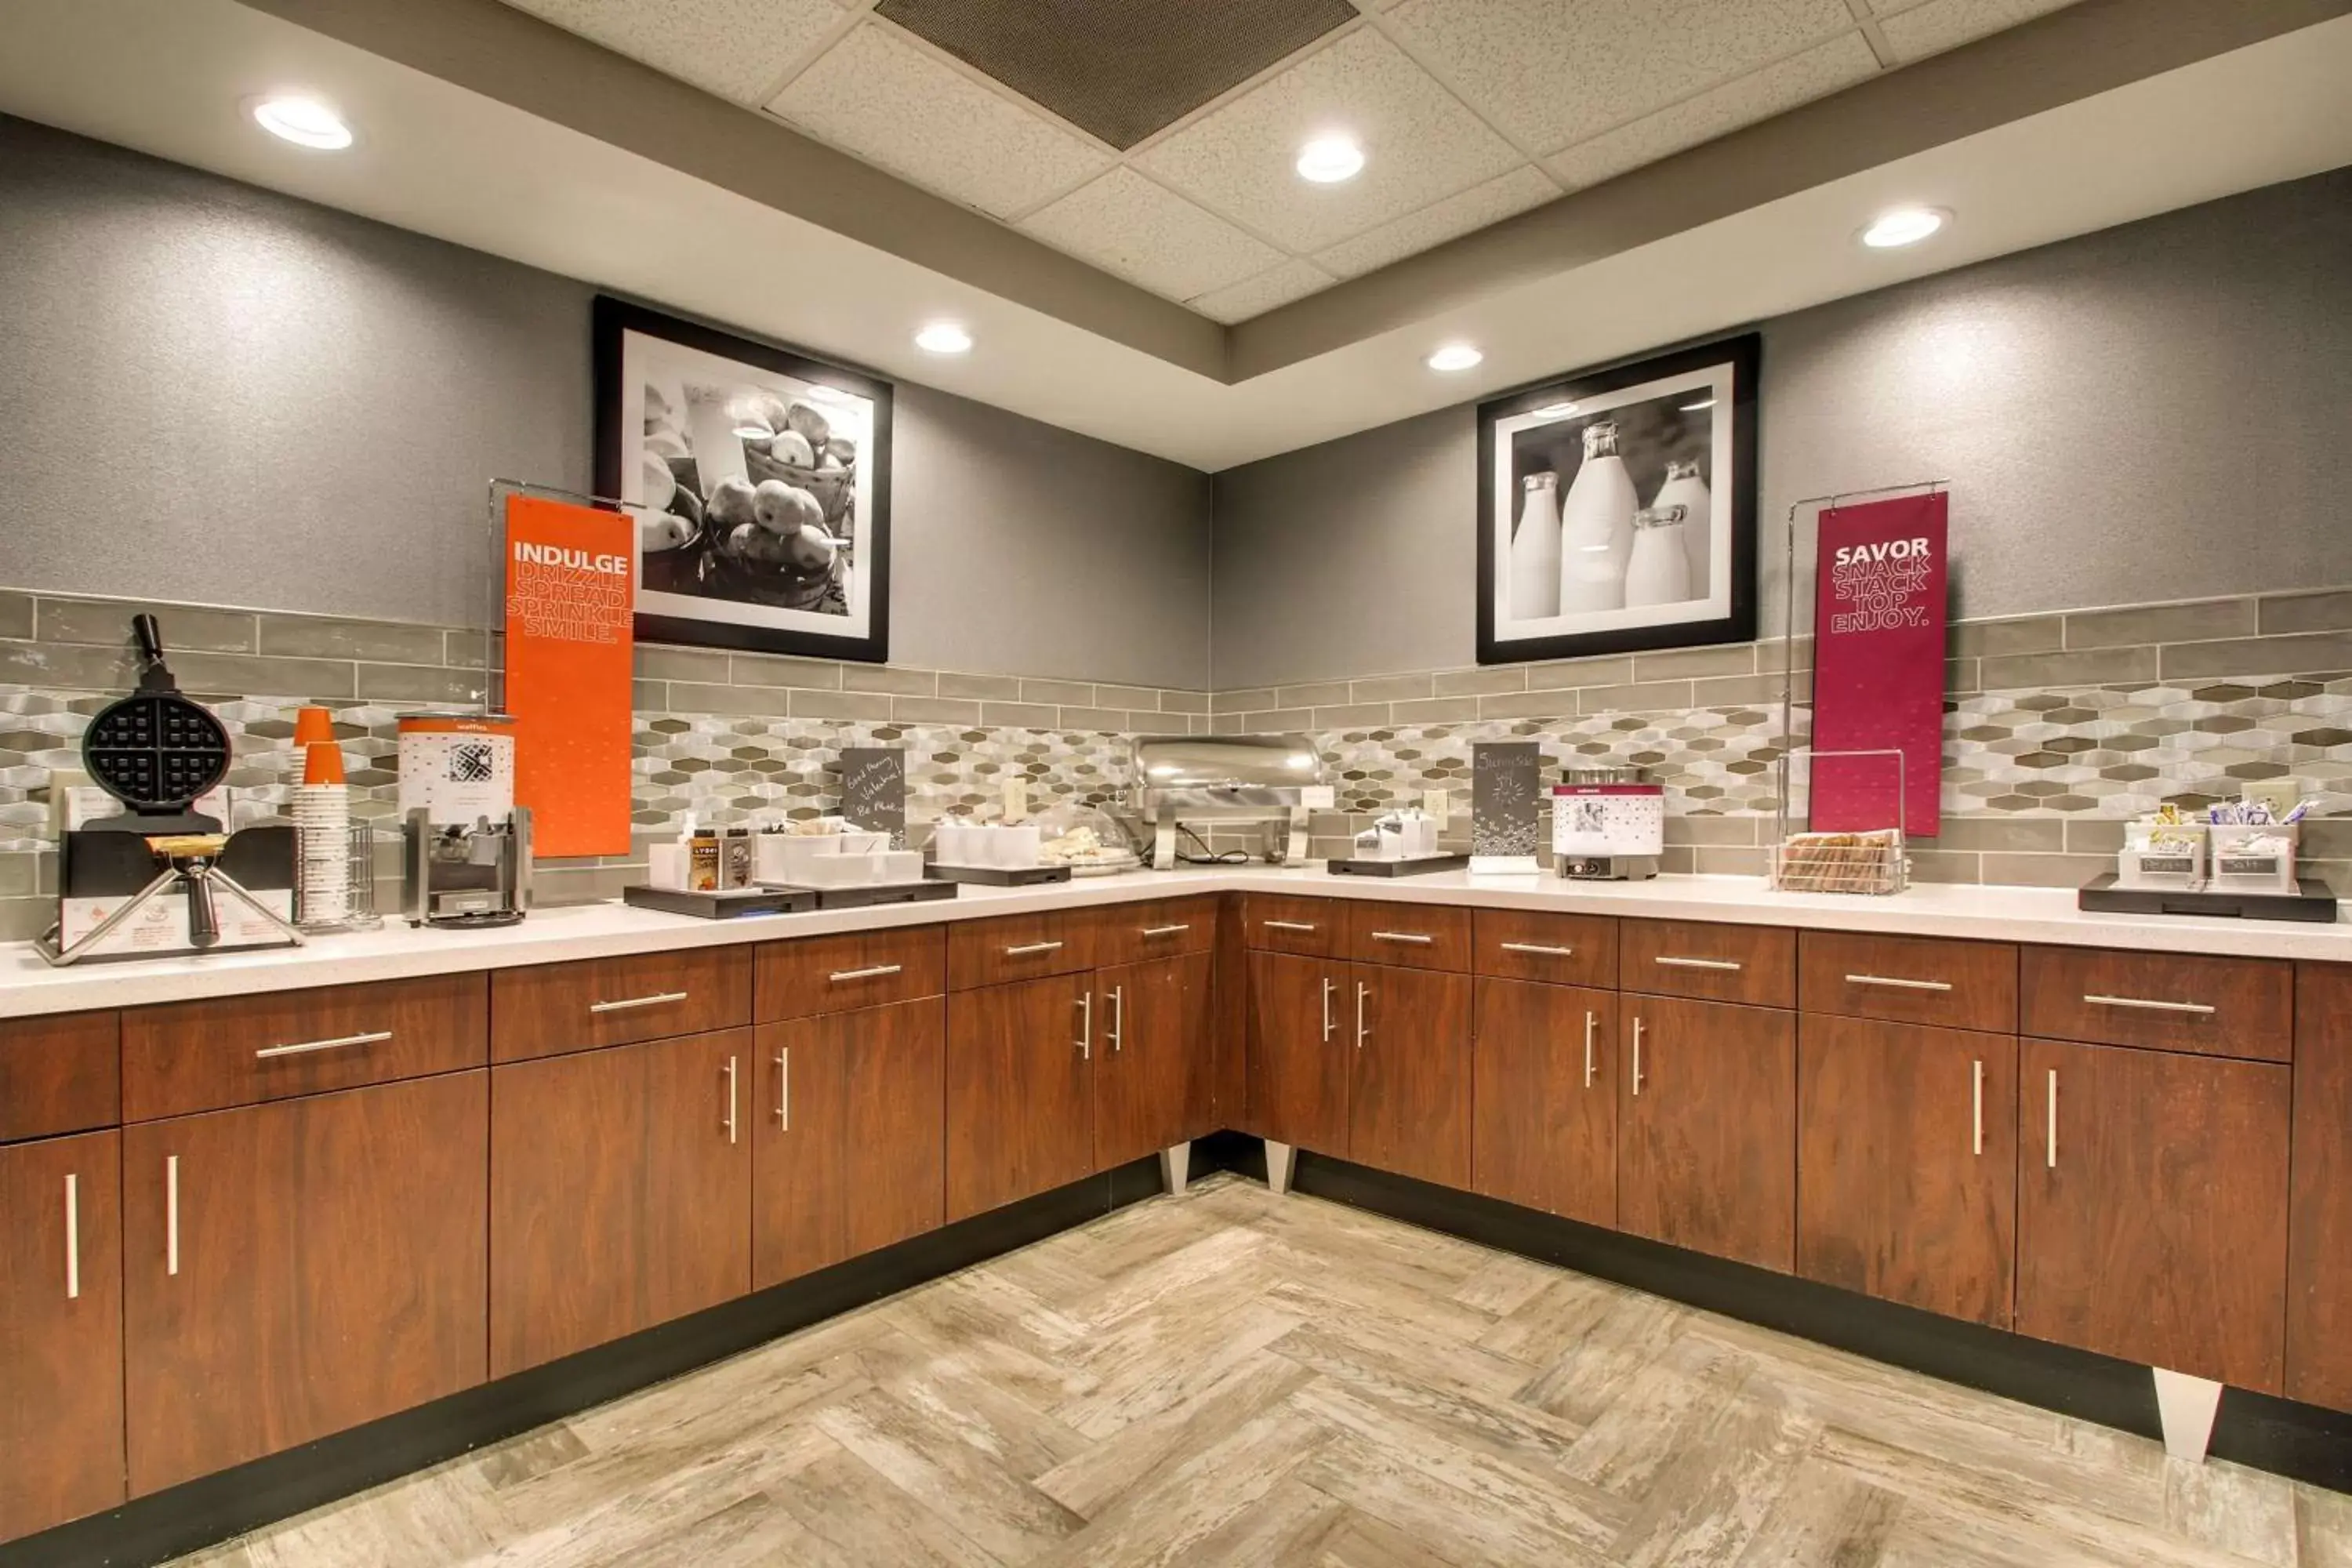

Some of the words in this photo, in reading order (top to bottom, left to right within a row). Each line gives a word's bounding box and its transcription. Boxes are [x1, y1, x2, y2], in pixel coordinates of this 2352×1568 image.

[514, 541, 628, 574] INDULGE
[1835, 538, 1929, 566] SAVOR
[516, 561, 627, 592] DRIZZLE
[1832, 554, 1932, 583] SNACK
[515, 579, 626, 608] SPREAD
[1835, 572, 1928, 600] STACK
[506, 596, 633, 628] SPRINKLE
[1853, 591, 1907, 612] TOP
[524, 615, 619, 644] SMILE.
[1831, 607, 1929, 633] ENJOY.
